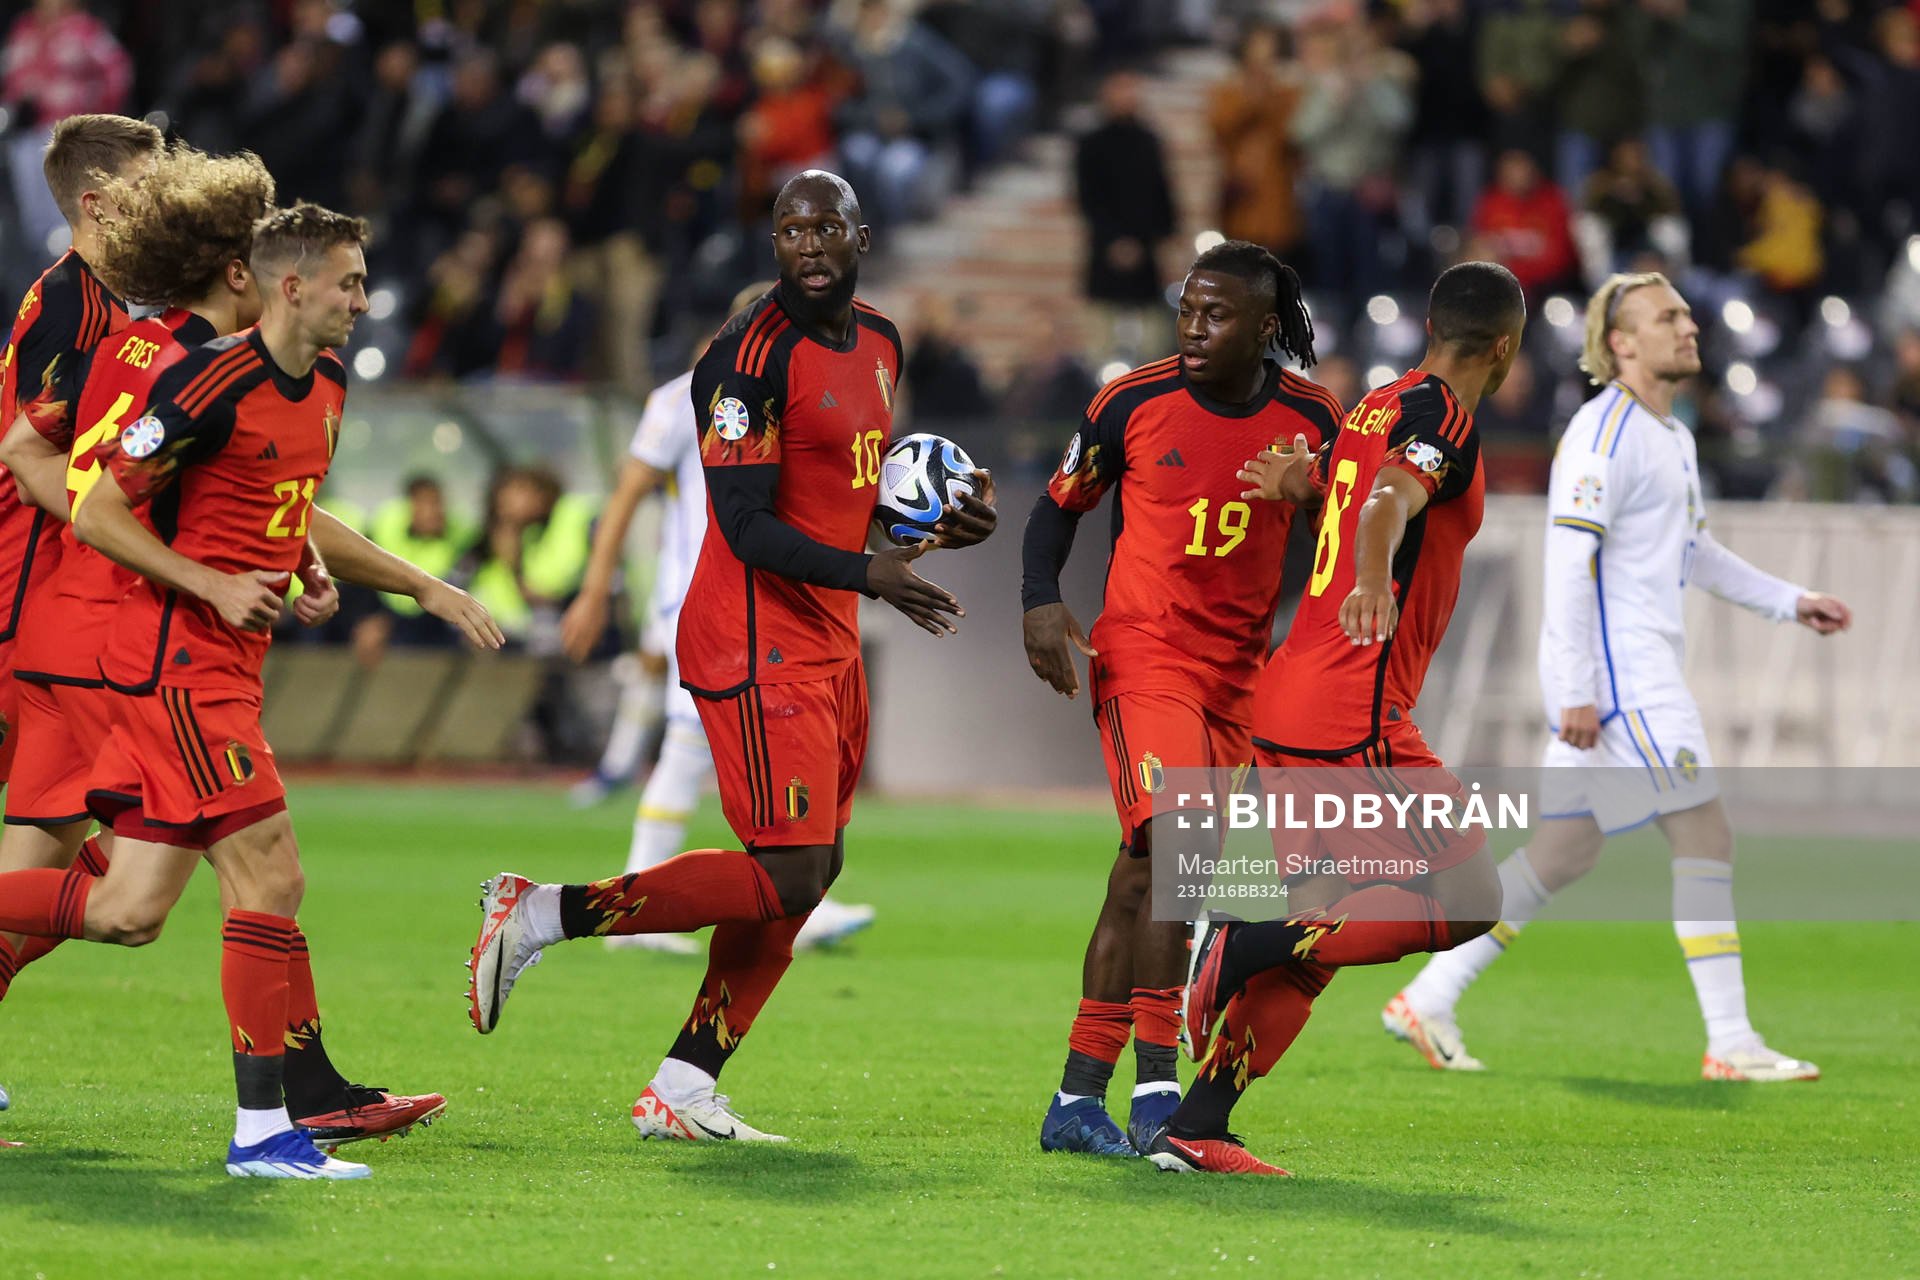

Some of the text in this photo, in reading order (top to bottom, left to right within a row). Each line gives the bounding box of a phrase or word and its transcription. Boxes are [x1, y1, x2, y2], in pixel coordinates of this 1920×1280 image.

[116, 335, 161, 369] FAES
[852, 429, 884, 489] 10
[266, 478, 314, 538] 21
[1185, 497, 1251, 557] 19
[1309, 458, 1358, 598] 8
